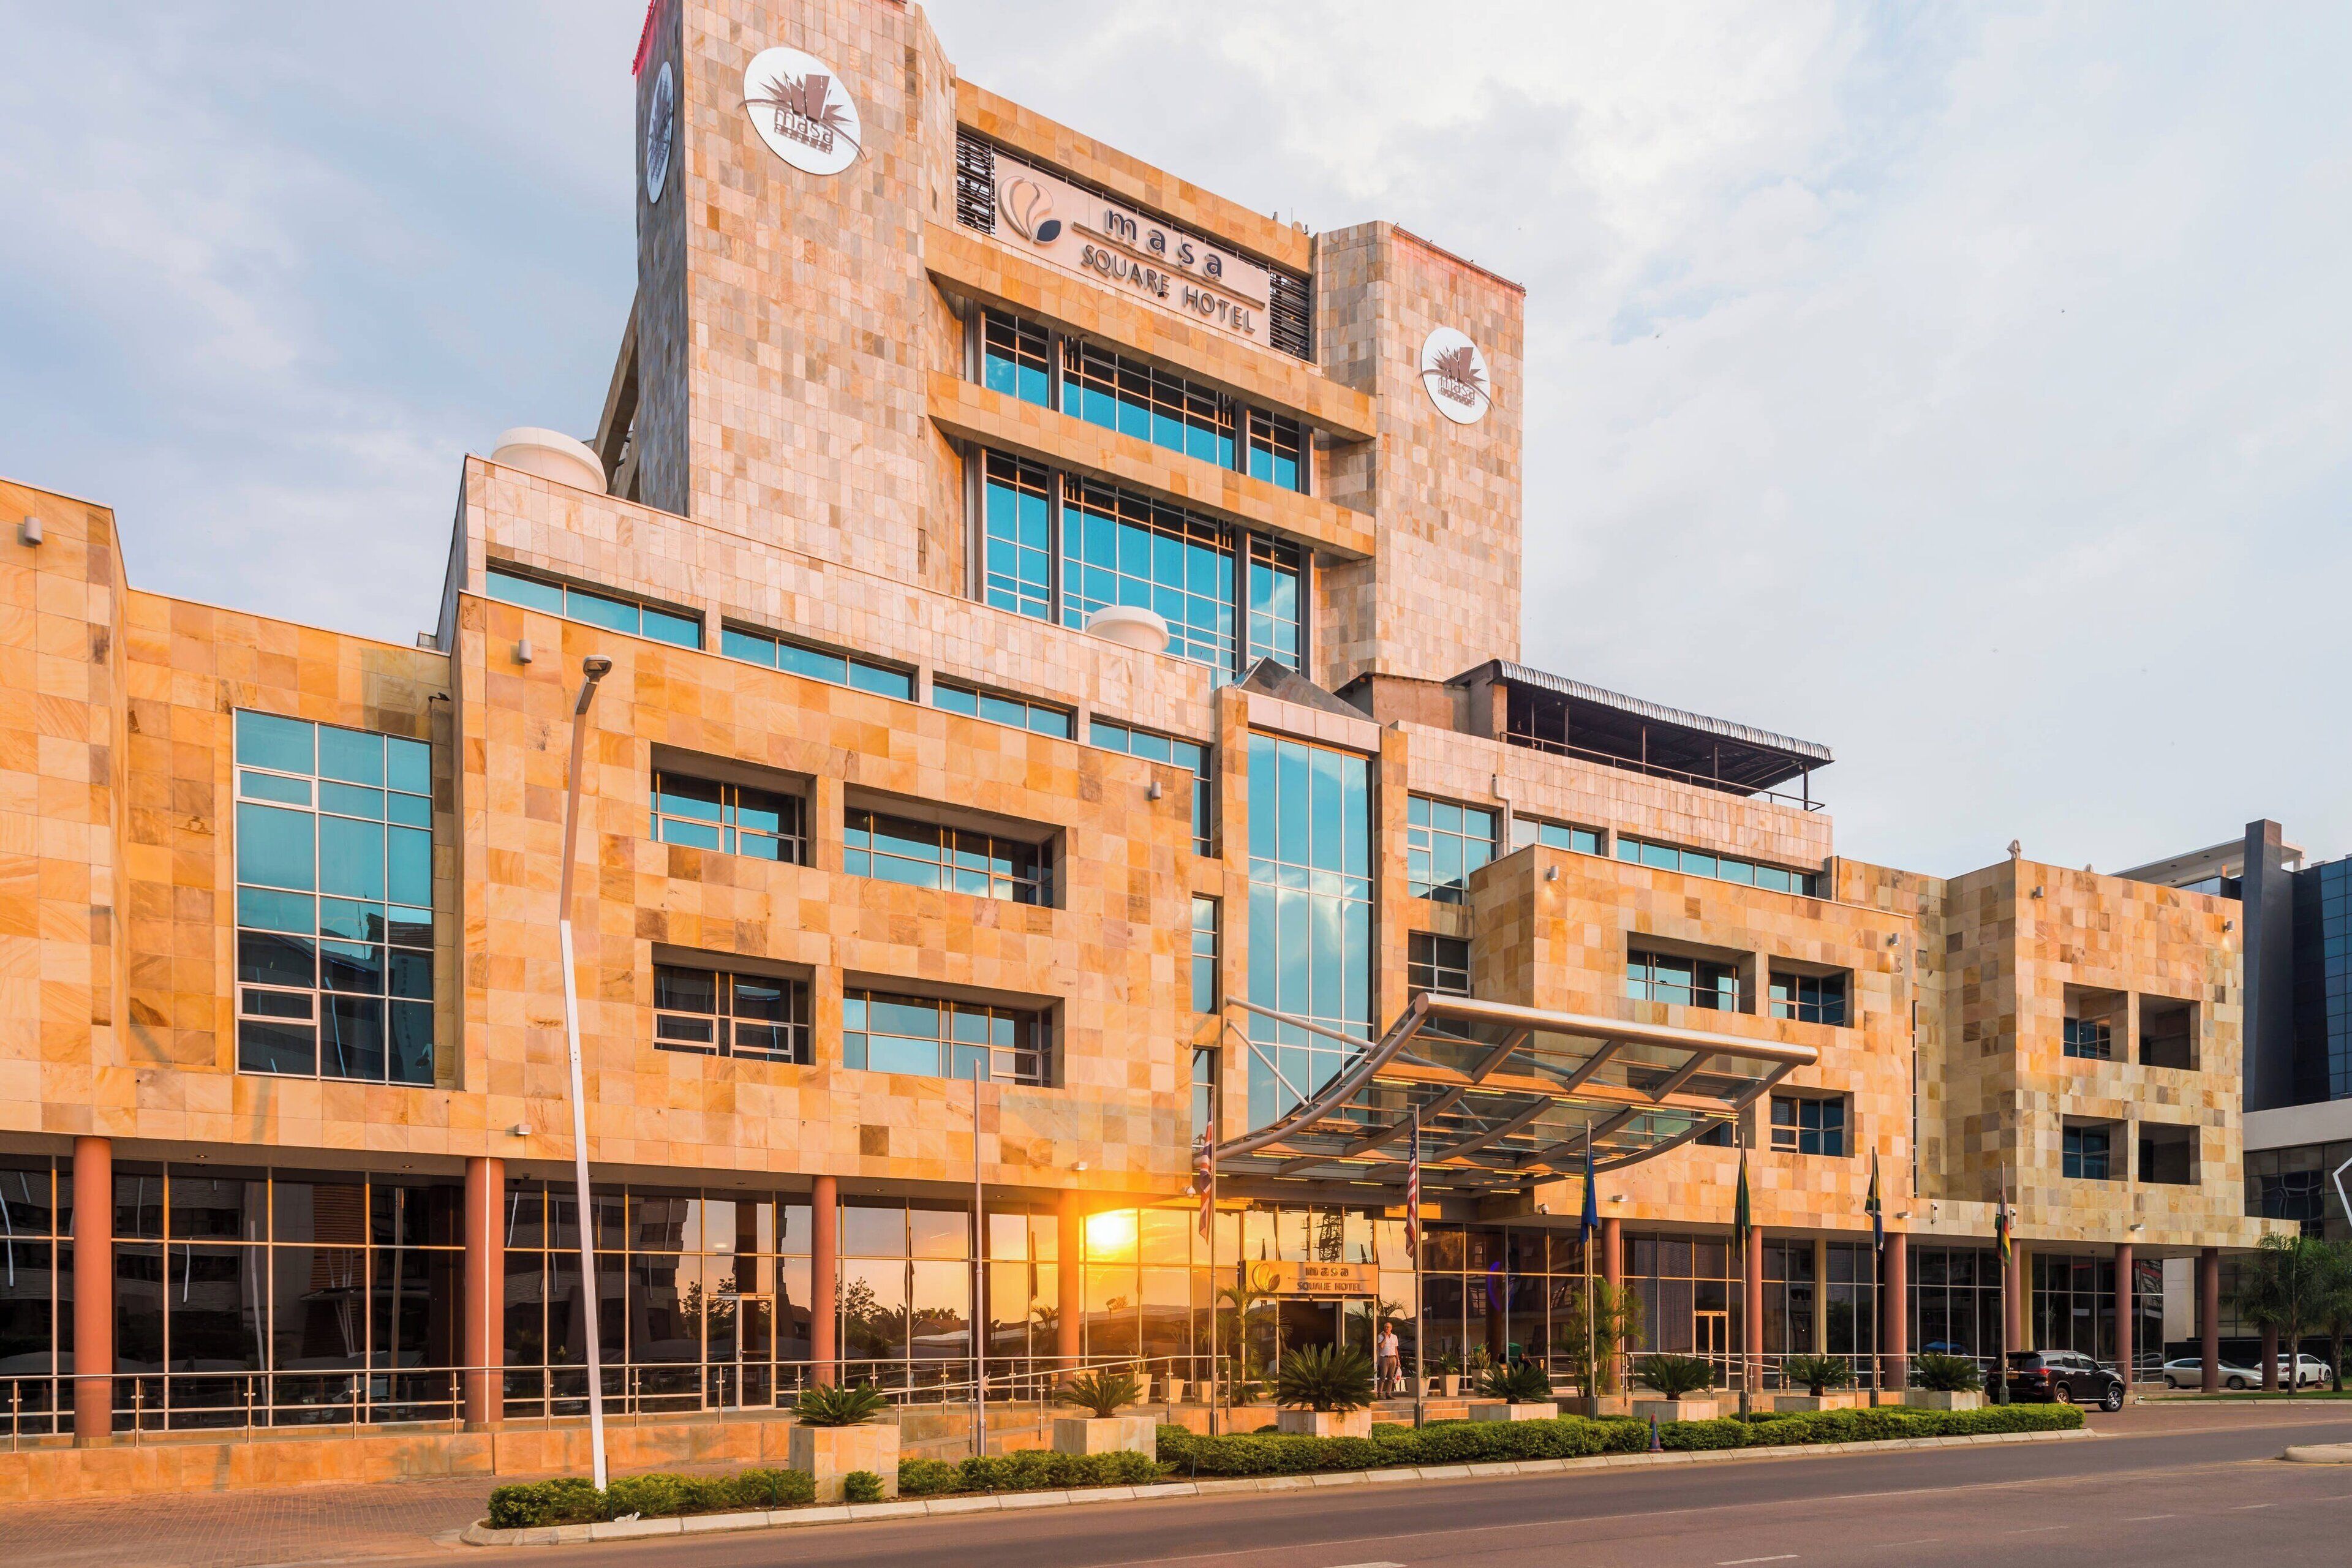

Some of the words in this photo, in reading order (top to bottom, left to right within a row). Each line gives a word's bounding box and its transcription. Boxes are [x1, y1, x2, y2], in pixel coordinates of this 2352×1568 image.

[775, 107, 834, 145] masa
[1106, 208, 1223, 280] masa
[1081, 244, 1170, 299] SQUARE
[1183, 285, 1256, 334] HOTEL
[1440, 375, 1475, 400] masa
[1305, 1267, 1349, 1276] masa
[1335, 1283, 1363, 1291] HOTEL
